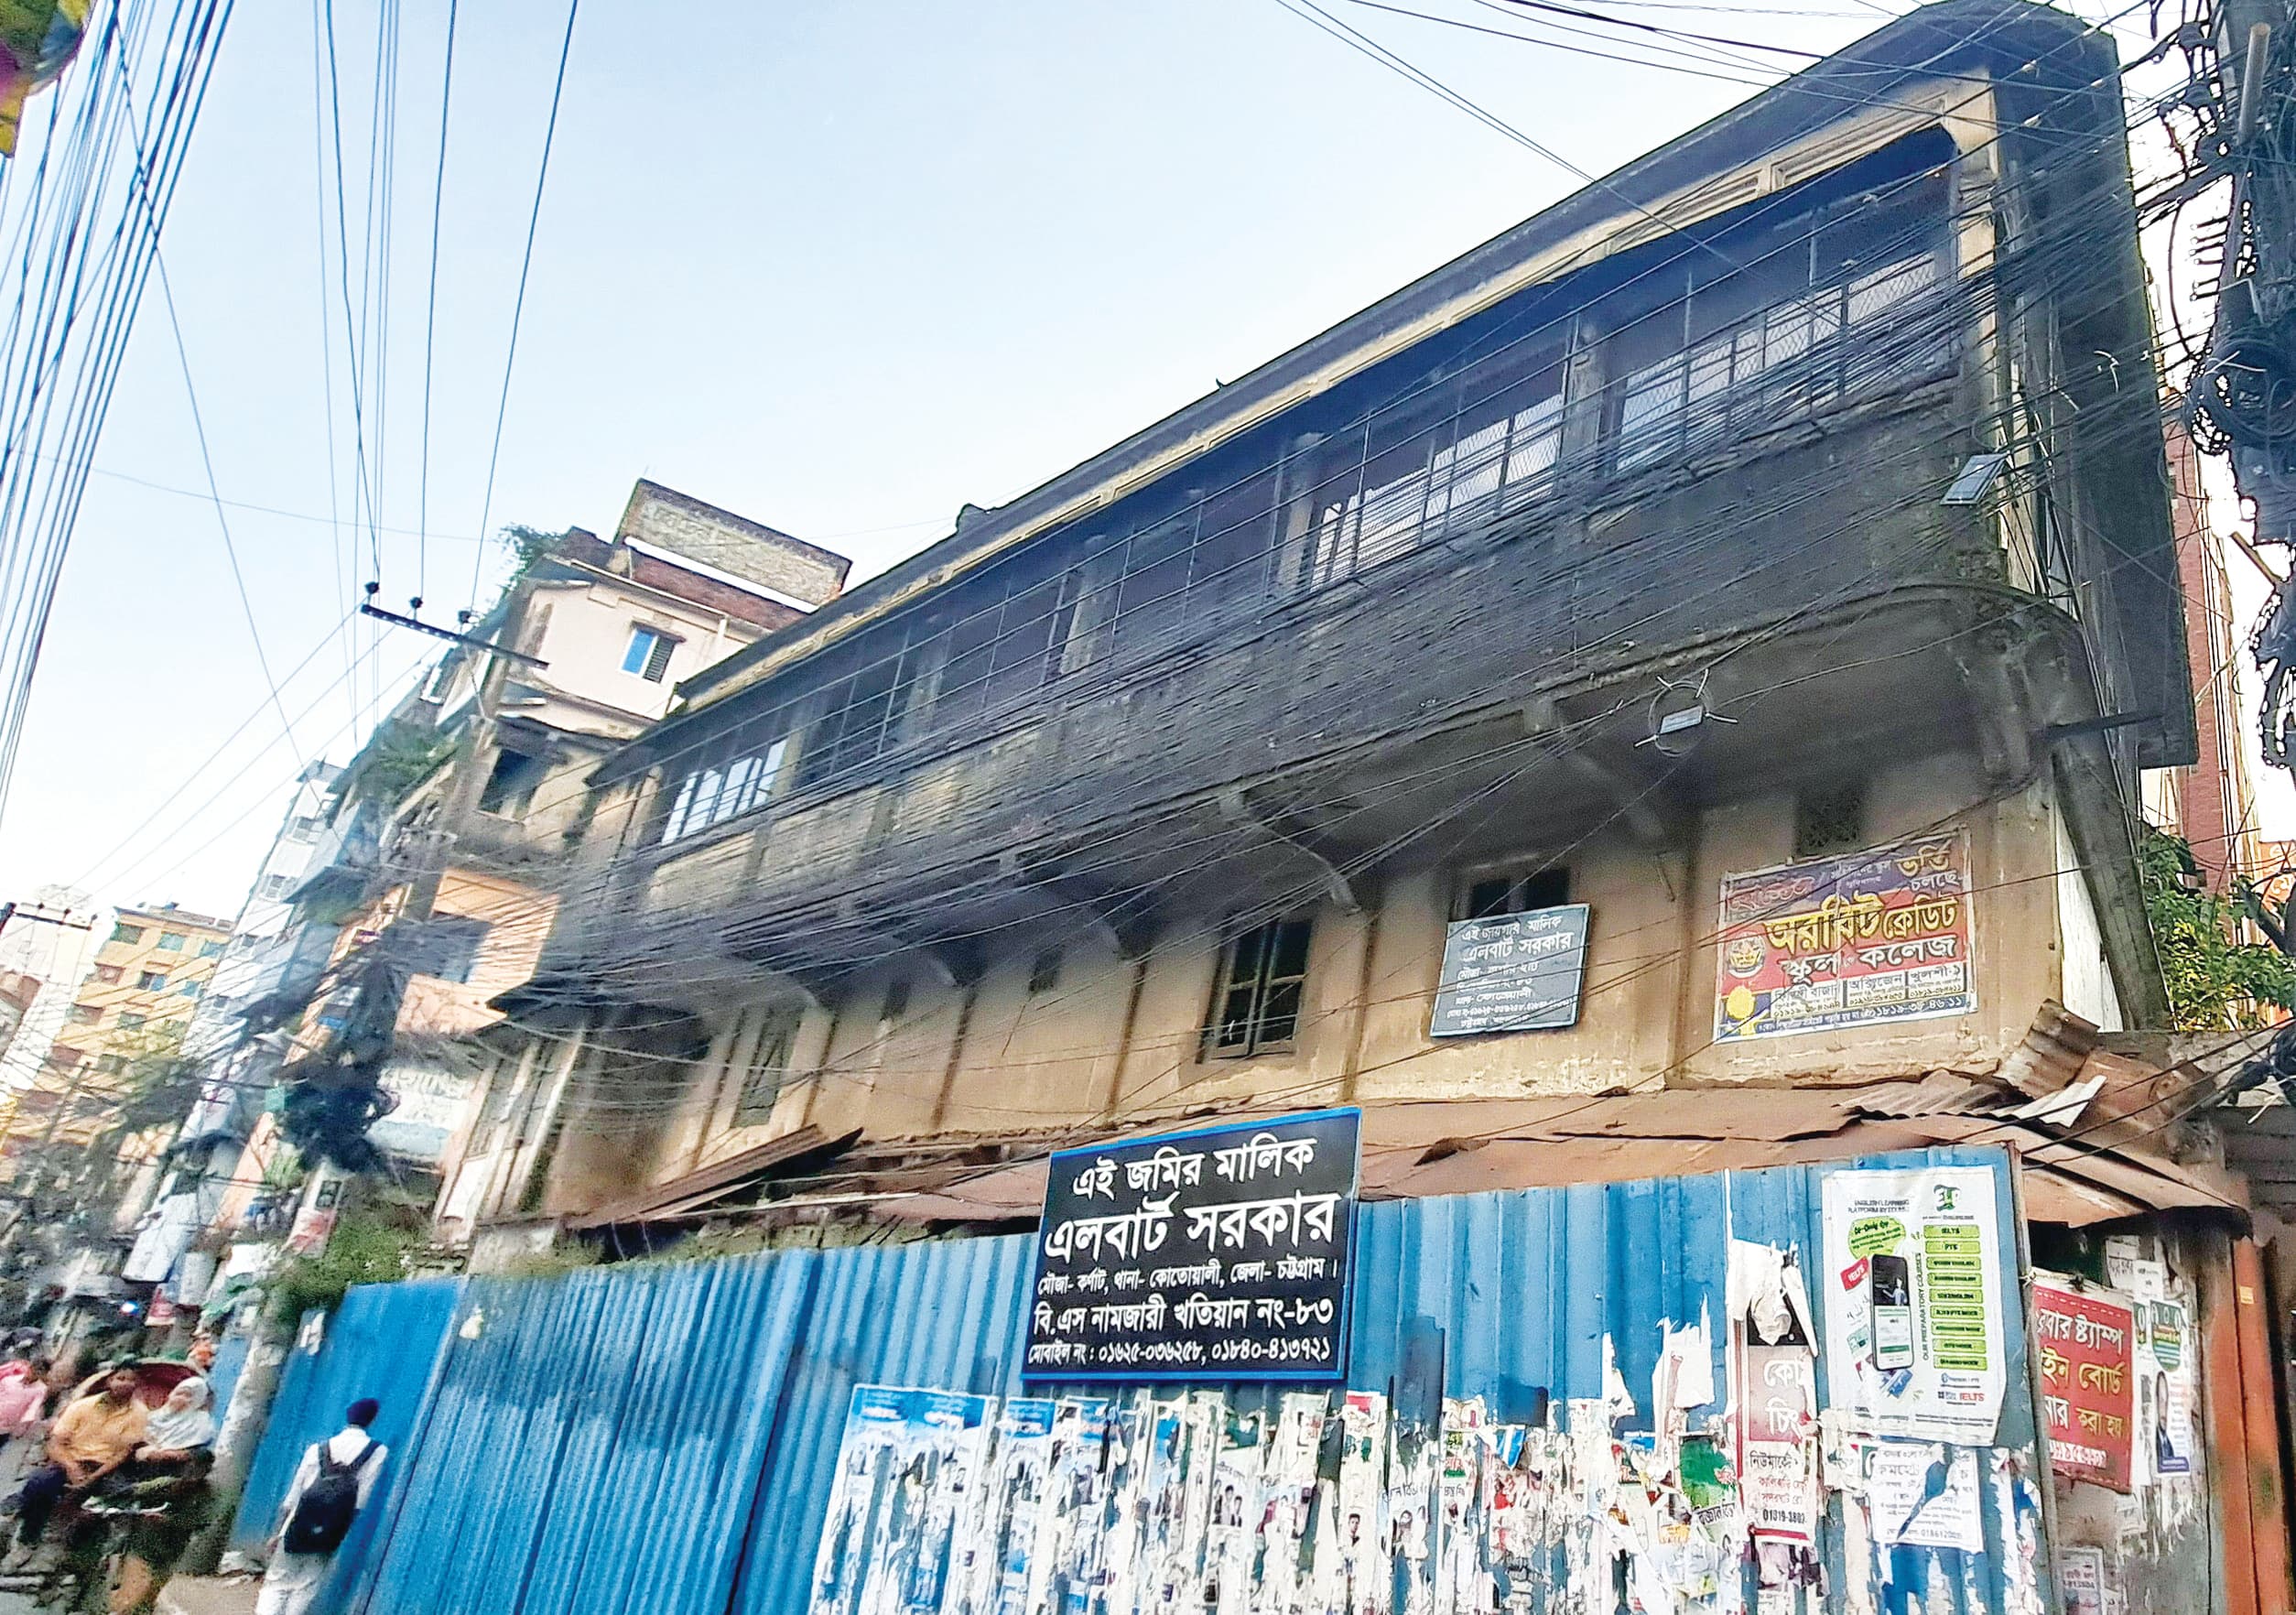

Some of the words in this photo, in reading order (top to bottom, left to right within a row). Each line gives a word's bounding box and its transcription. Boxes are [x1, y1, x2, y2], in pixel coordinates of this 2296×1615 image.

[1895, 840, 1952, 876] ভর্তি
[1912, 870, 1960, 891] চলছে
[1461, 927, 1479, 940] এই
[1527, 914, 1563, 932] মালিক
[1460, 936, 1515, 962] এলবার্ট
[1519, 931, 1575, 954] সরকার
[1779, 949, 1838, 984] স্কুল
[1857, 935, 1957, 969] কলেজ
[1073, 1156, 1118, 1200] এই
[1124, 1146, 1206, 1191] জমির
[1213, 1133, 1318, 1182] মালিক
[1045, 1191, 1180, 1263] এলবার্ট
[1183, 1189, 1342, 1252] সরকার
[1114, 1268, 1145, 1291] থানা-
[1150, 1258, 1225, 1288] কোতোয়ালী,
[1230, 1260, 1273, 1284] জেলা-
[1847, 1263, 1865, 1282] IELTS
[1034, 1301, 1087, 1335] বি.এস
[1091, 1293, 1167, 1333] নামজারী
[1174, 1292, 1251, 1328] খতিয়ান
[1255, 1298, 1334, 1329] নং-৮৩
[1918, 1289, 1927, 1342] PREPARATORY
[1028, 1339, 1071, 1365] মোবাইল
[1212, 1337, 1330, 1362] ০১৮৪০-৪১৩৭২১
[2079, 1361, 2126, 1394] বোর্ড
[1959, 1392, 1985, 1402] IELTS
